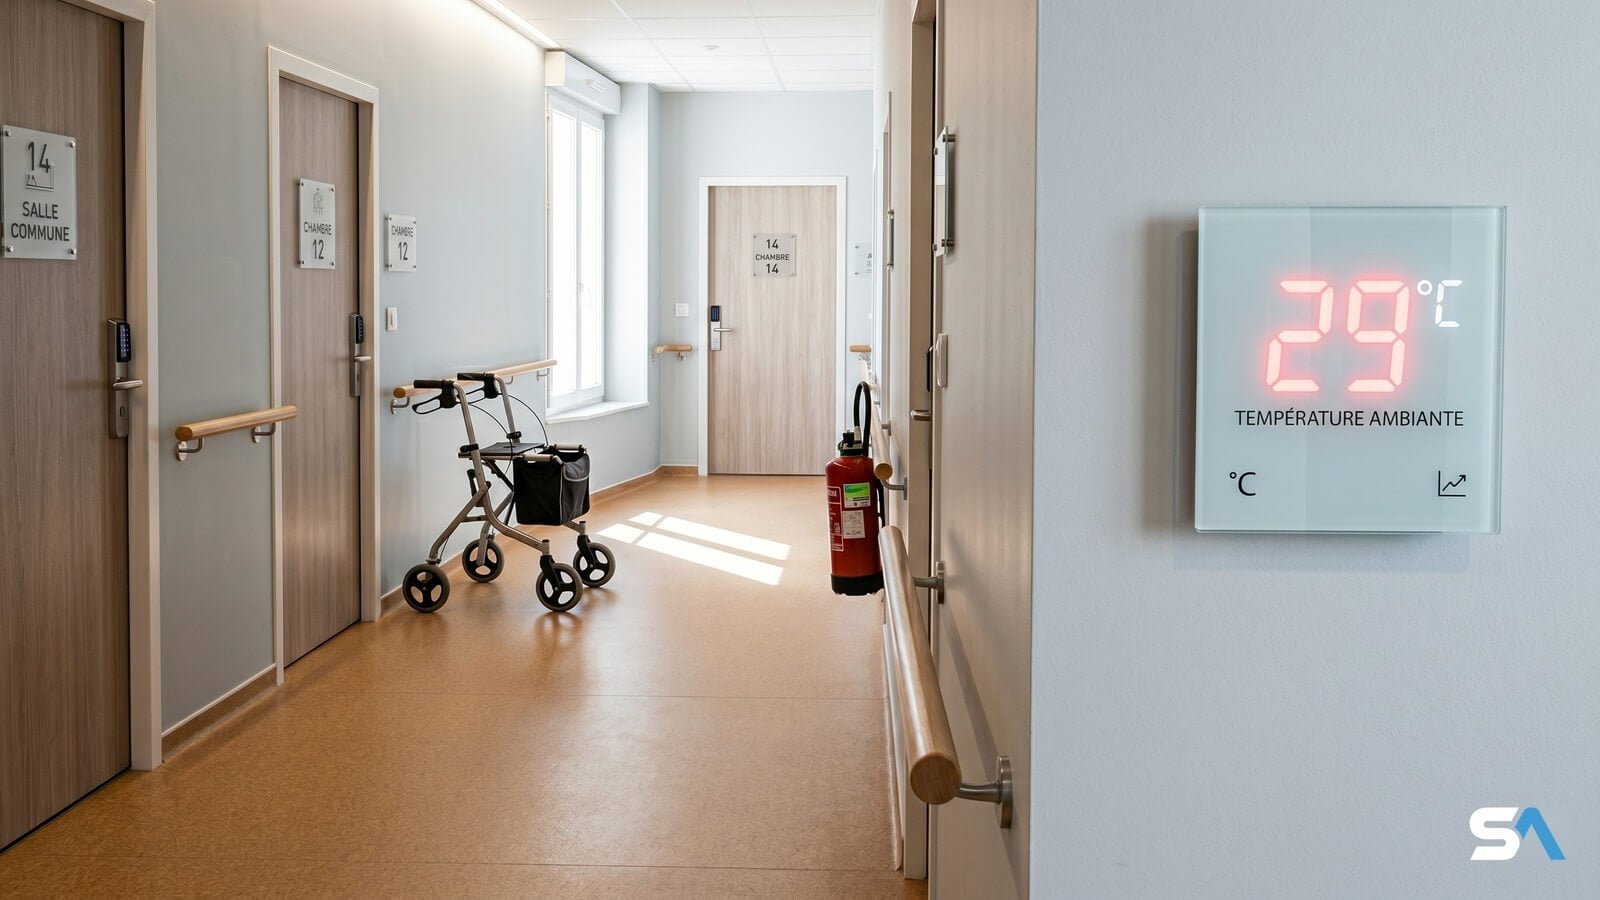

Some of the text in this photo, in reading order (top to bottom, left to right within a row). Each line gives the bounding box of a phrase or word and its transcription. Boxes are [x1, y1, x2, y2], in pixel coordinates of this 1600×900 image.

[27, 141, 51, 173] 14
[22, 201, 59, 219] SALLE
[11, 223, 70, 241] COMMUNE
[303, 221, 332, 235] CHAMBRE
[391, 225, 414, 237] CHAMBRE
[312, 239, 324, 260] 12
[398, 241, 408, 261] 12
[766, 239, 778, 249] 14
[755, 253, 789, 261] CHAMBRE
[766, 263, 778, 273] 14
[1266, 280, 1410, 392] 29
[1234, 407, 1464, 427] TEMPÉRATURE AMBIANTE
